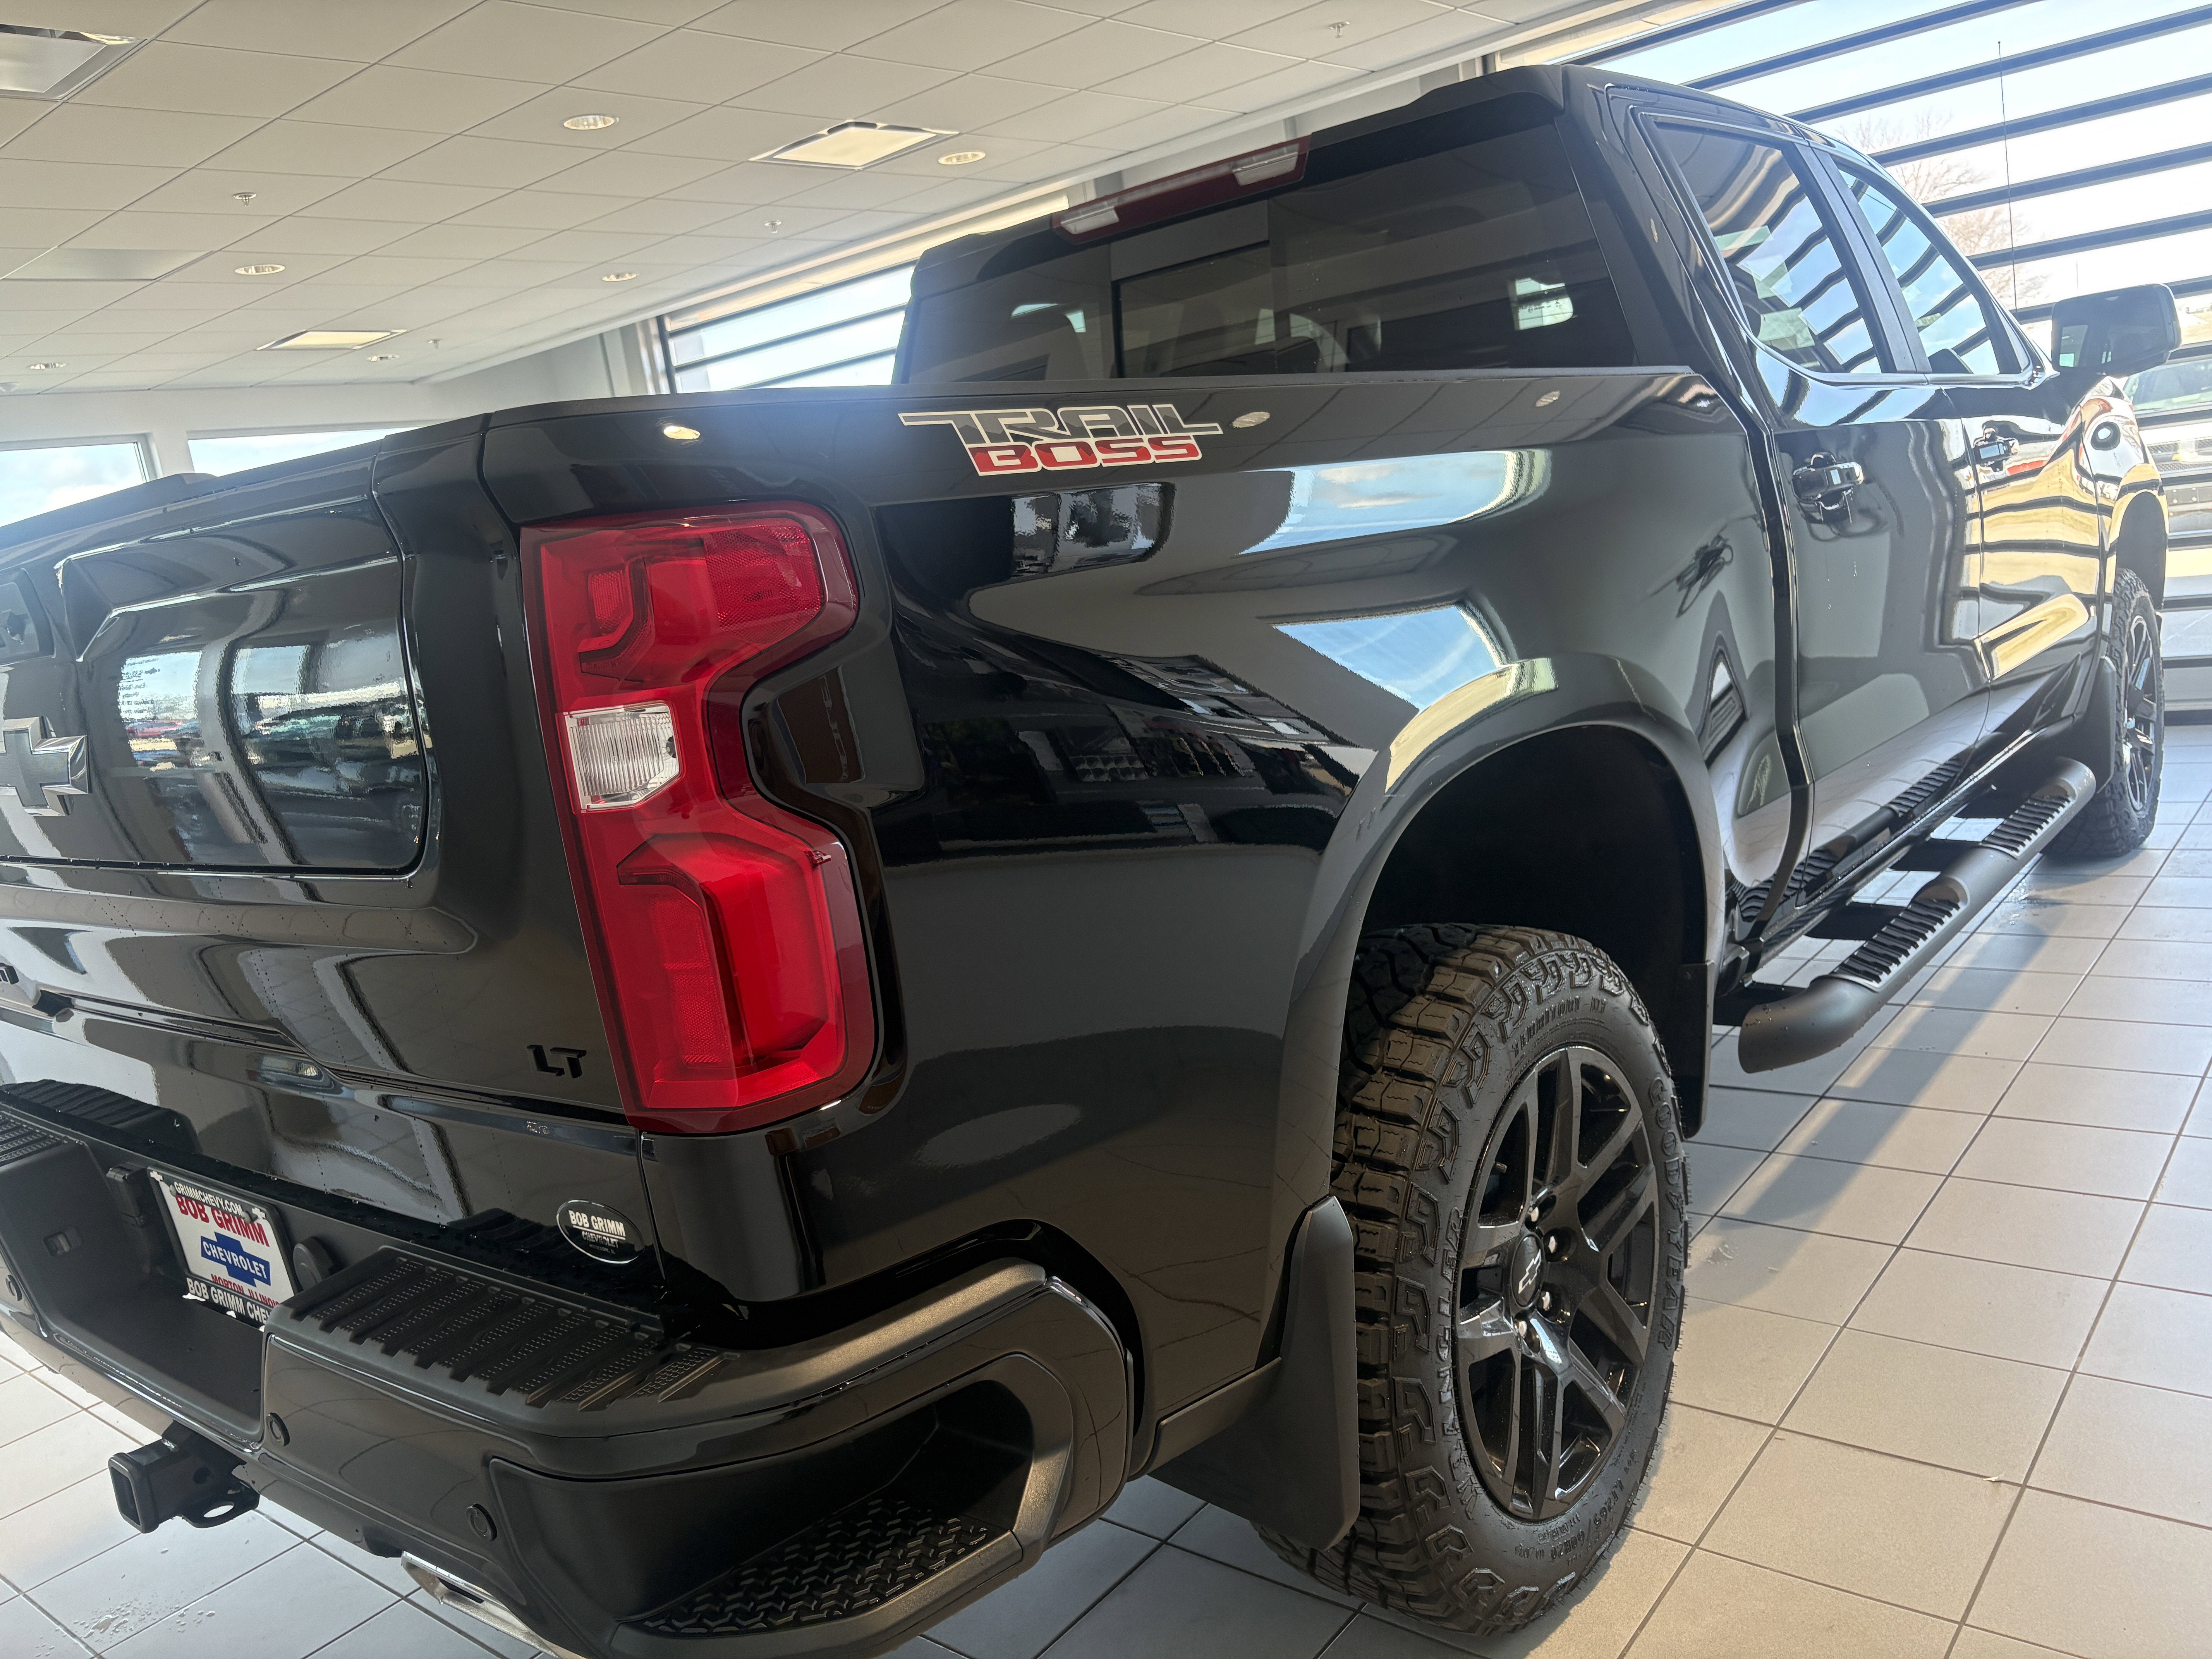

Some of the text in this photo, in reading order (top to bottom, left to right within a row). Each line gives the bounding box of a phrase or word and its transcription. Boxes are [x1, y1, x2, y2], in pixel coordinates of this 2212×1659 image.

[898, 404, 1223, 445] TRAIL
[967, 434, 1202, 476] BOSS
[1512, 995, 1580, 1058] TERRITORY
[527, 1044, 587, 1079] LT
[174, 1182, 243, 1217] GRIMMCHEVY.COM
[1649, 1077, 1685, 1350] GOODYEAR
[175, 1195, 270, 1247] BOB GRIMM
[568, 1210, 626, 1237] BOB GRIMM
[582, 1231, 618, 1249] CHEVROLET
[203, 1241, 267, 1279] CHEVROLET
[186, 1277, 209, 1300] BOB
[210, 1286, 246, 1316] GRIMM
[211, 1273, 244, 1294] MORTON
[1437, 1207, 1483, 1520] WRANGLER
